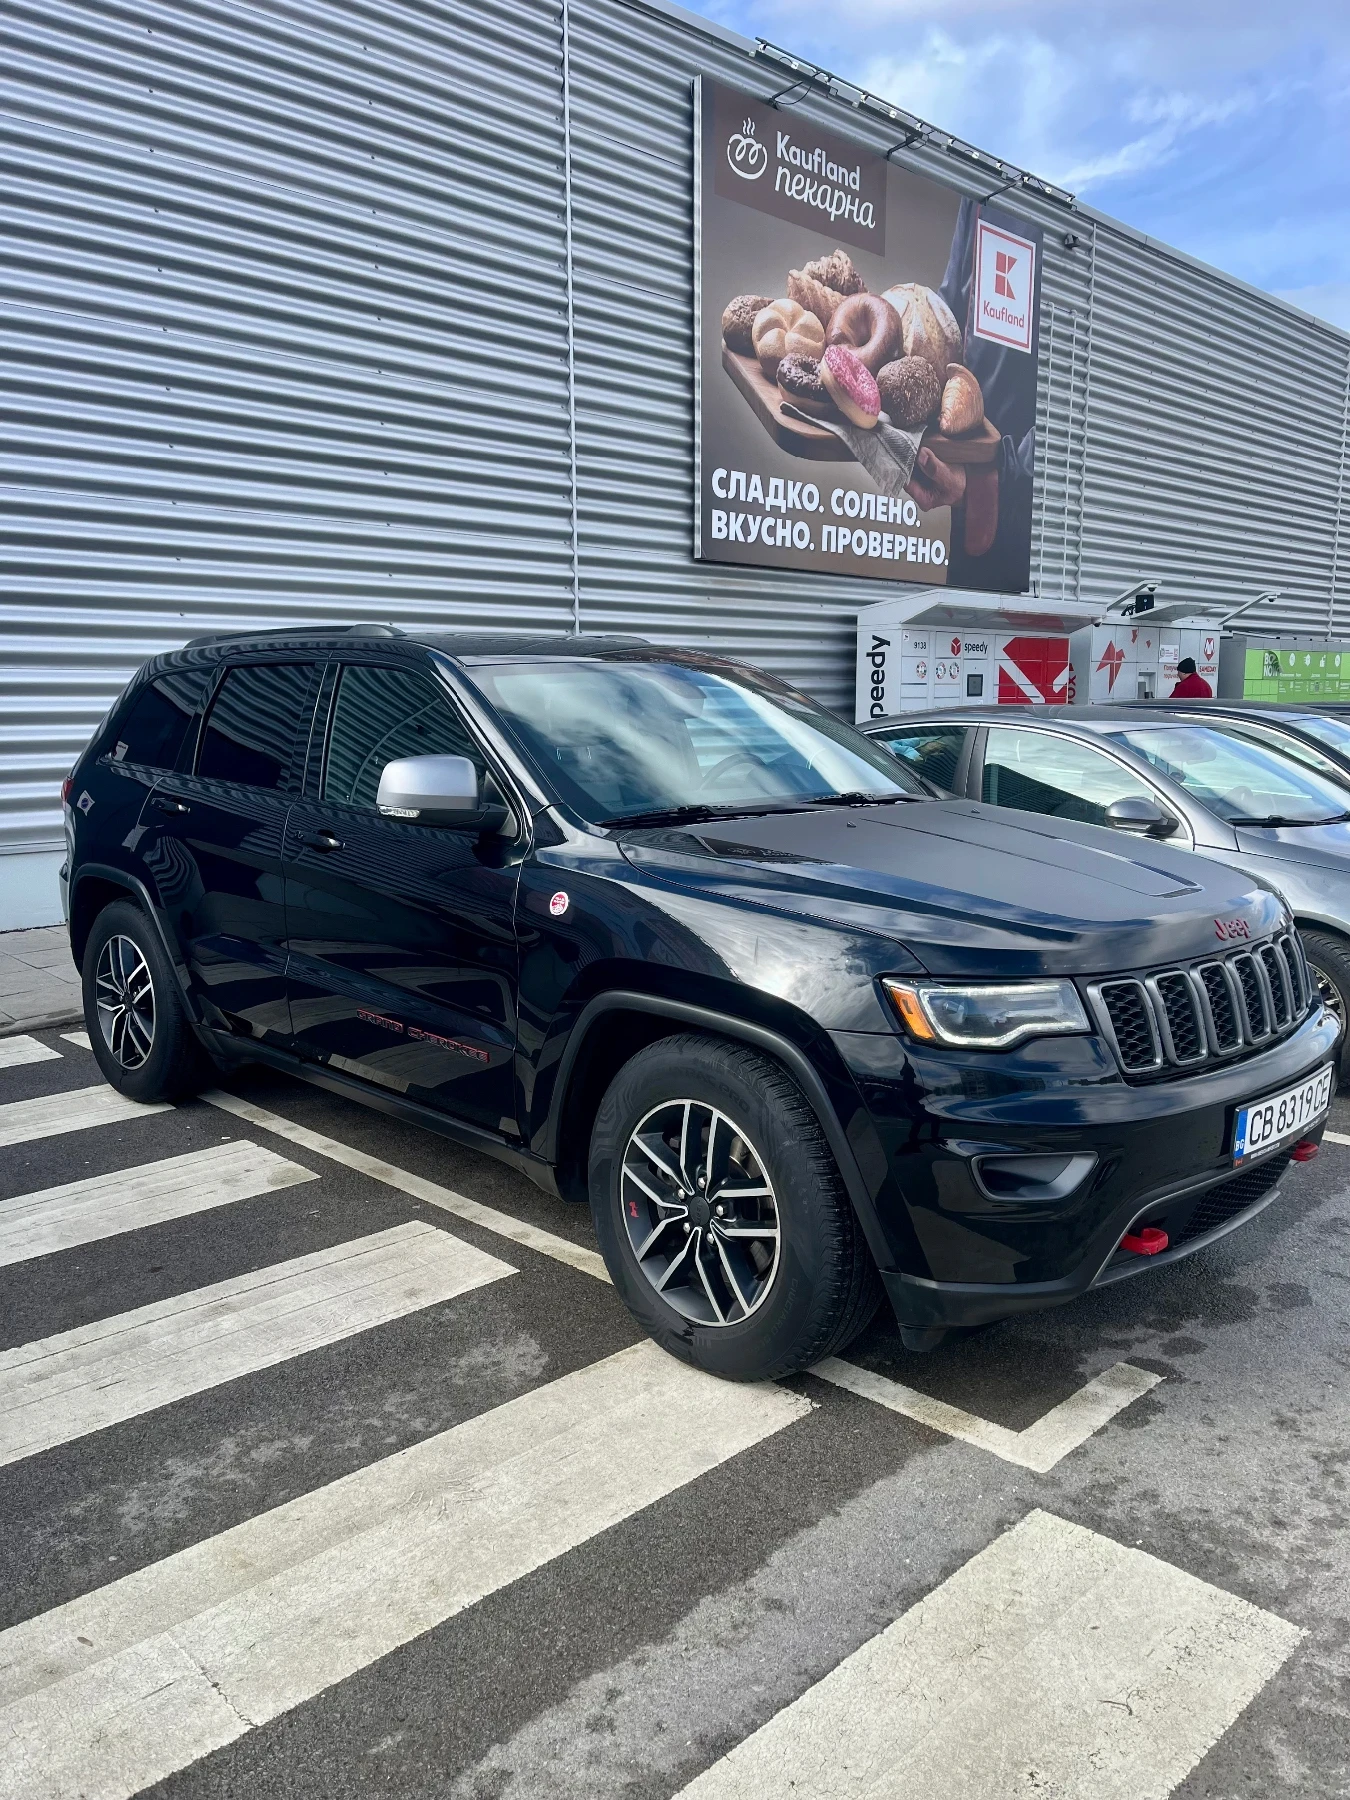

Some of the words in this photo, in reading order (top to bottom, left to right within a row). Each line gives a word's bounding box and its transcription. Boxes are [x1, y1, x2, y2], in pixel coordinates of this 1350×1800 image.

[775, 130, 861, 192] Kaufland
[774, 166, 876, 229] пекарна
[982, 301, 1025, 329] Kaufland
[711, 467, 825, 514] СЛАДКО.
[830, 488, 921, 528] СОЛЕНО.
[711, 509, 815, 551] ВКУСНО.
[821, 525, 949, 567] ПРОВЕРЕНО.
[913, 641, 927, 650] 9138
[964, 641, 989, 654] speedy
[865, 634, 891, 718] peedy
[1213, 917, 1251, 941] Jeep
[1235, 1138, 1245, 1152] BG
